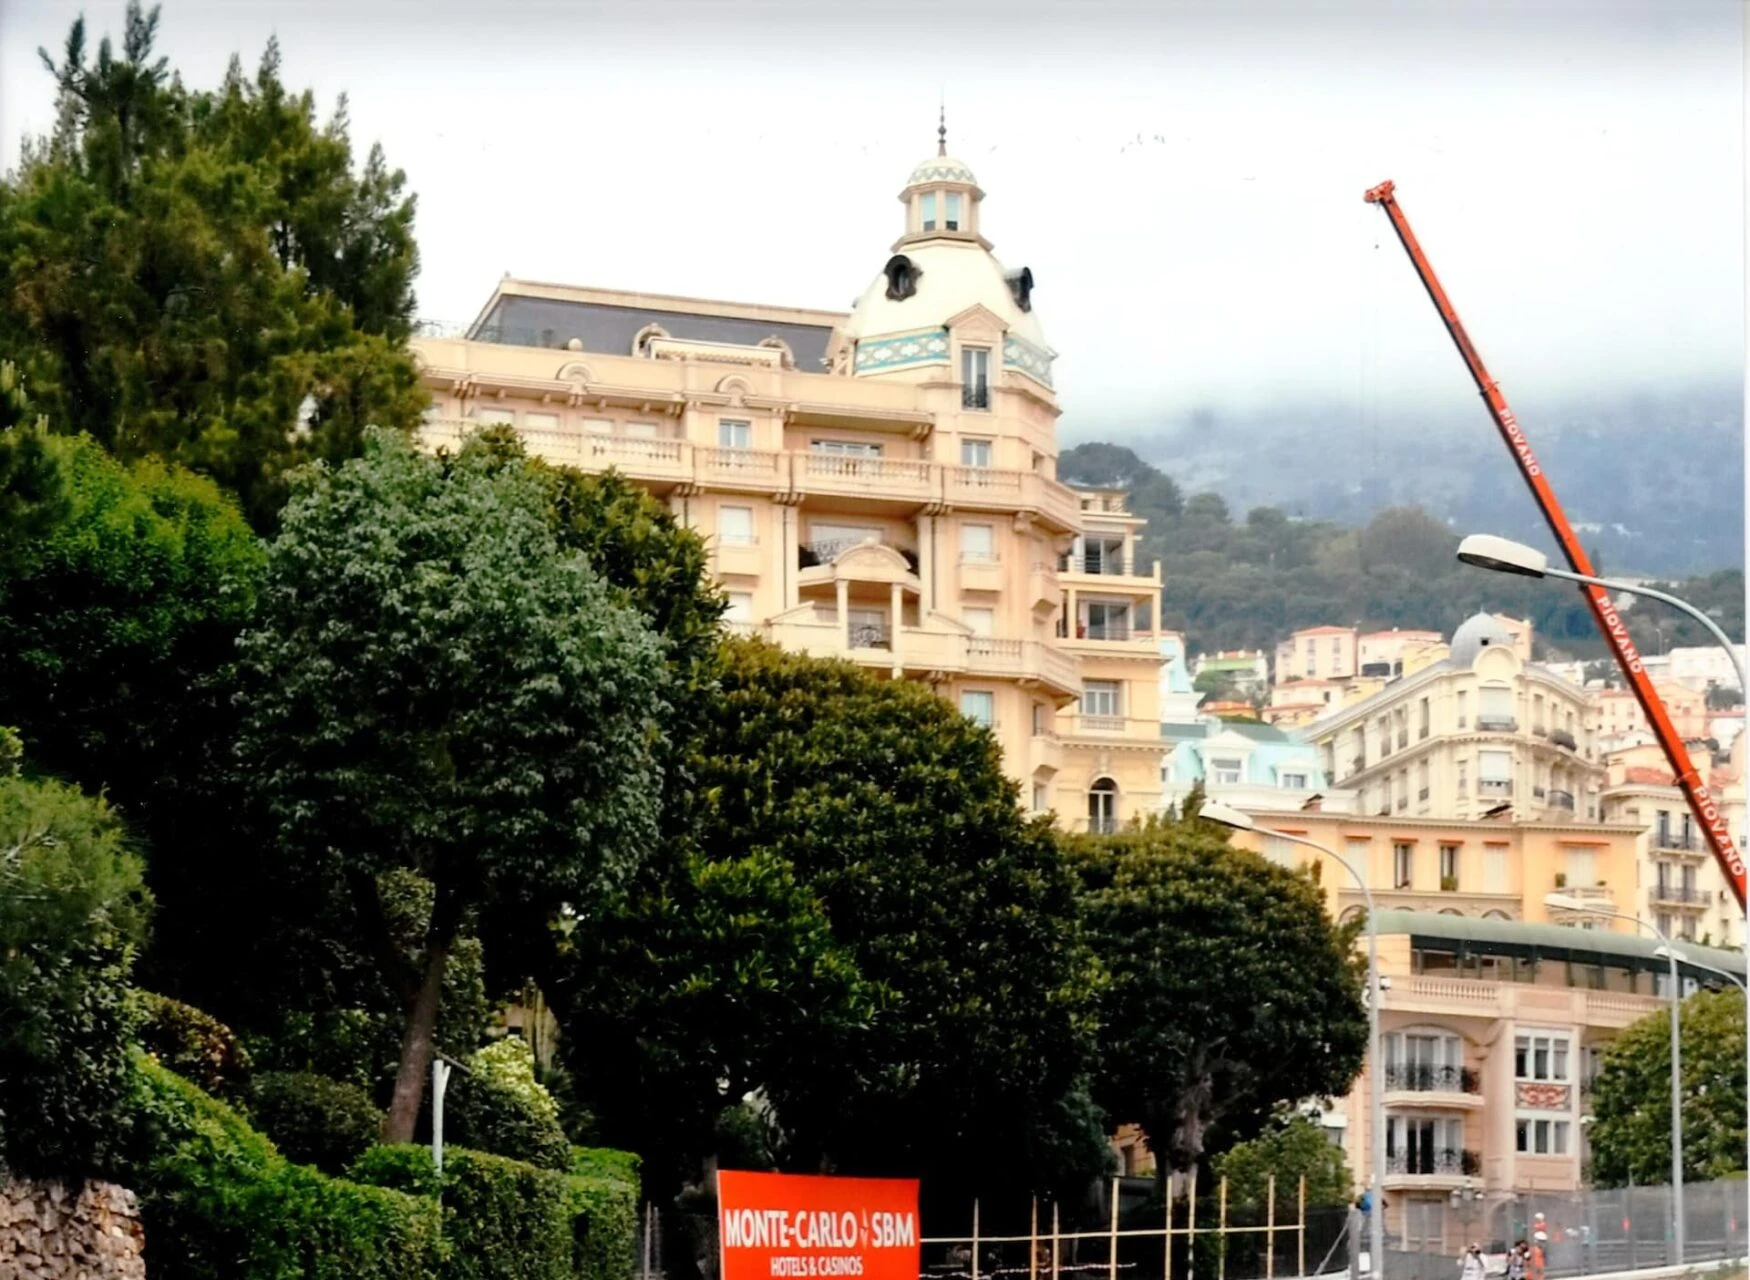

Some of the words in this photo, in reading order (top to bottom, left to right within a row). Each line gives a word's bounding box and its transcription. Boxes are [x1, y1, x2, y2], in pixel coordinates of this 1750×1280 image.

[1499, 408, 1541, 476] PIOVANO
[1597, 596, 1643, 674] PIOVANO
[1693, 786, 1745, 875] PIOVANO
[725, 1209, 858, 1248] MONTE-CARLO
[871, 1212, 915, 1248] SBM
[771, 1256, 808, 1277] HOTELS
[809, 1256, 817, 1276] &
[818, 1255, 864, 1276] CASINOS
